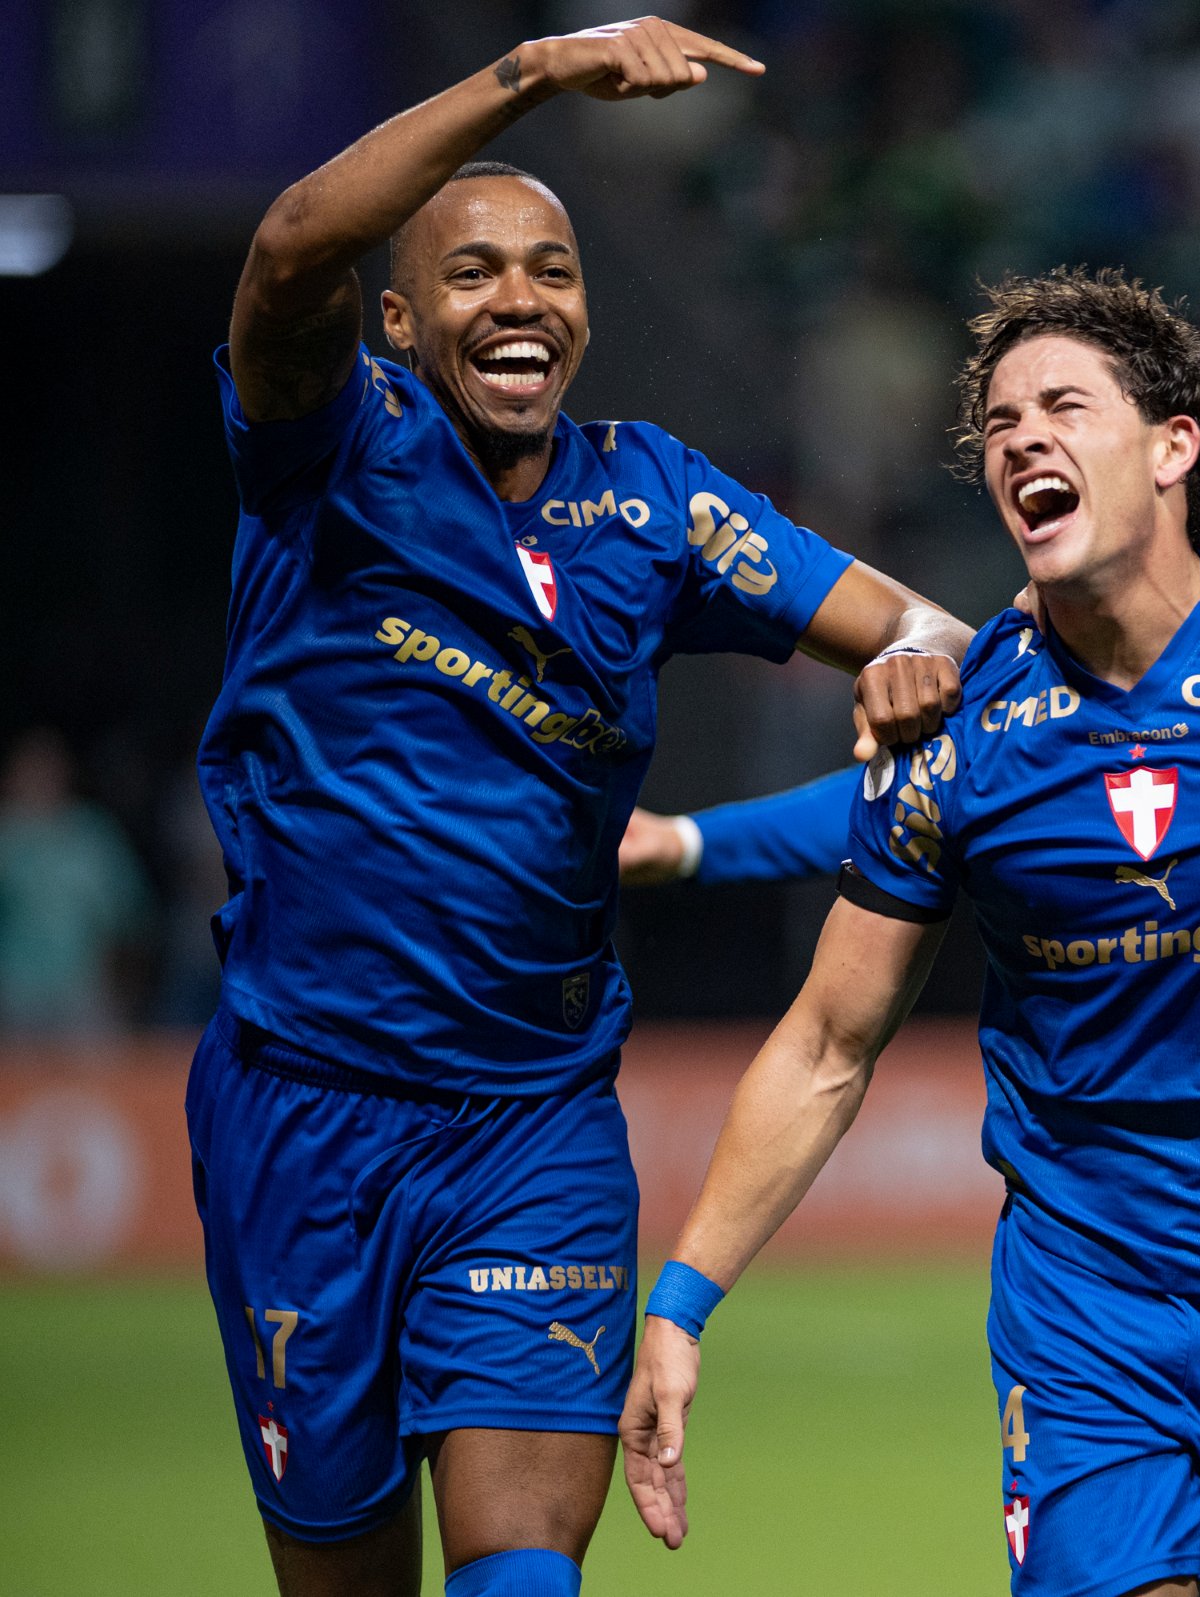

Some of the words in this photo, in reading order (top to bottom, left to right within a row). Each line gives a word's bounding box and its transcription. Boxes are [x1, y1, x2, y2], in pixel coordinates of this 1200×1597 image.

[541, 489, 651, 528] CIMD
[981, 686, 1081, 732] CMED
[1088, 728, 1172, 745] Embracon
[468, 1265, 629, 1293] UNIASSELVI
[244, 1305, 299, 1390] 17
[1002, 1385, 1030, 1462] 4
